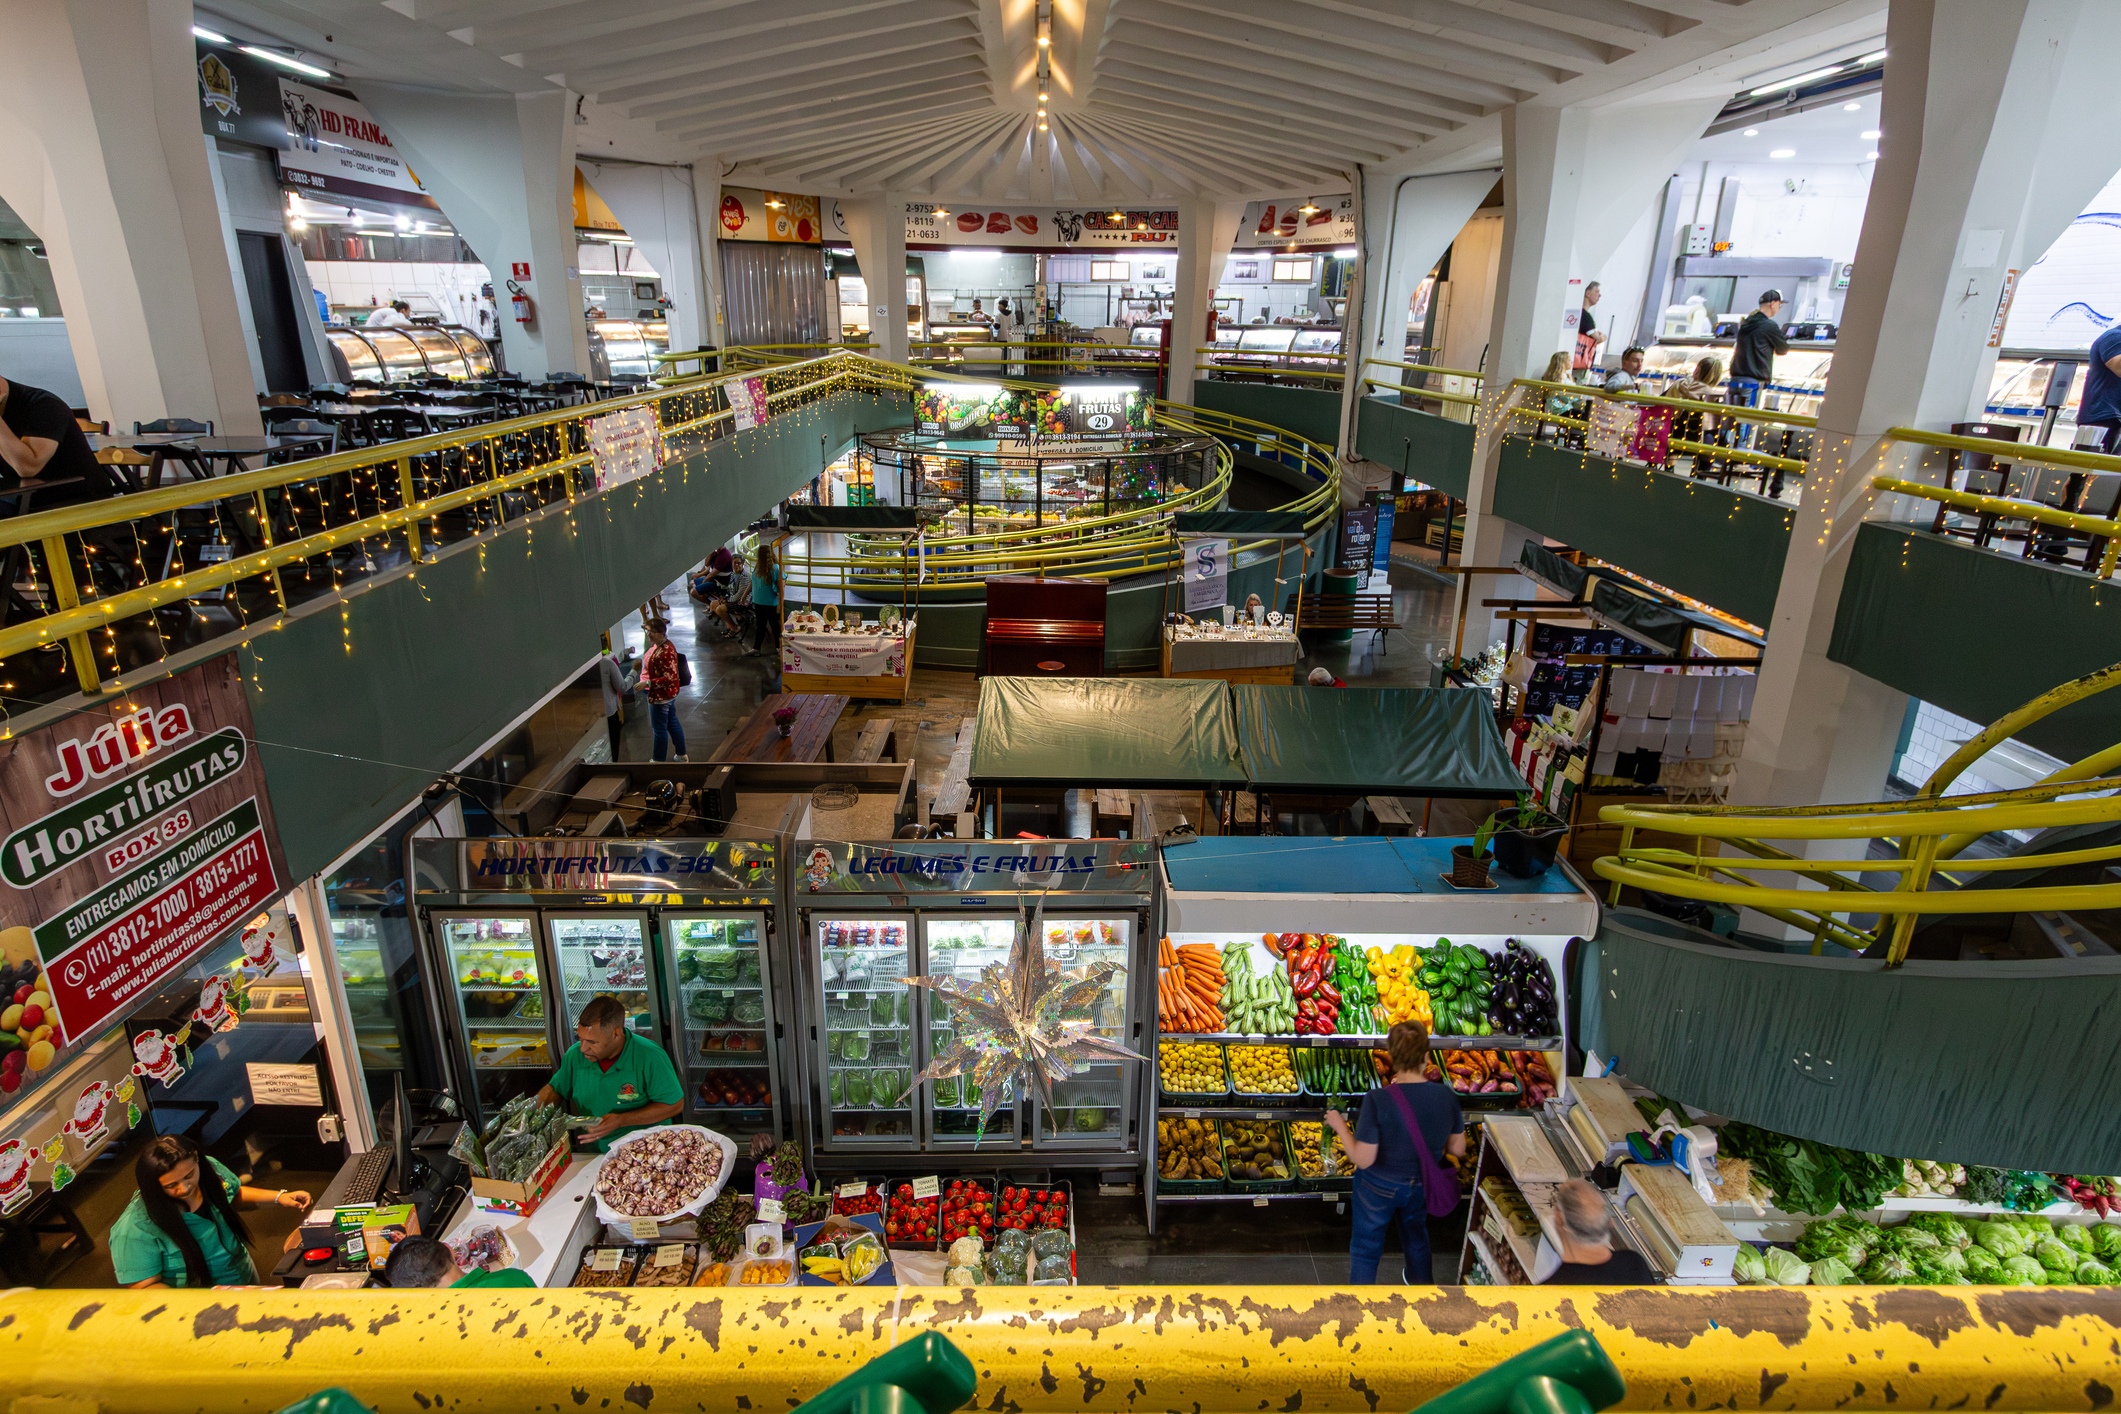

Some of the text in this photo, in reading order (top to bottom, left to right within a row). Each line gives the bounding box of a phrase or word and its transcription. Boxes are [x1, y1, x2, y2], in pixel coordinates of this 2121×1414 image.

[320, 108, 341, 133] HD
[340, 159, 397, 177] PATO COELHO CHESTER
[906, 217, 934, 226] 1-8119
[1126, 211, 1149, 230] DE
[905, 230, 940, 239] 21-0633
[1130, 232, 1168, 243] PJJ
[1079, 404, 1121, 414] FRUTAS
[1094, 417, 1108, 428] 29
[50, 707, 190, 792] Júlia
[108, 812, 190, 870] BOX 38
[477, 856, 715, 877] HORTIFRUTAS 38
[848, 855, 1098, 874] LEGUMES E FRUTAS
[65, 872, 158, 939] ENTREGAMOS
[159, 857, 180, 882] EM
[86, 941, 112, 974] (11)
[111, 888, 189, 958] 3812-7000
[197, 840, 260, 900] 3815-1771
[86, 870, 259, 1000] E-mail: hortifrutas38@uol.com.br
[111, 894, 251, 1001] www.juliahortifrutas.com.br
